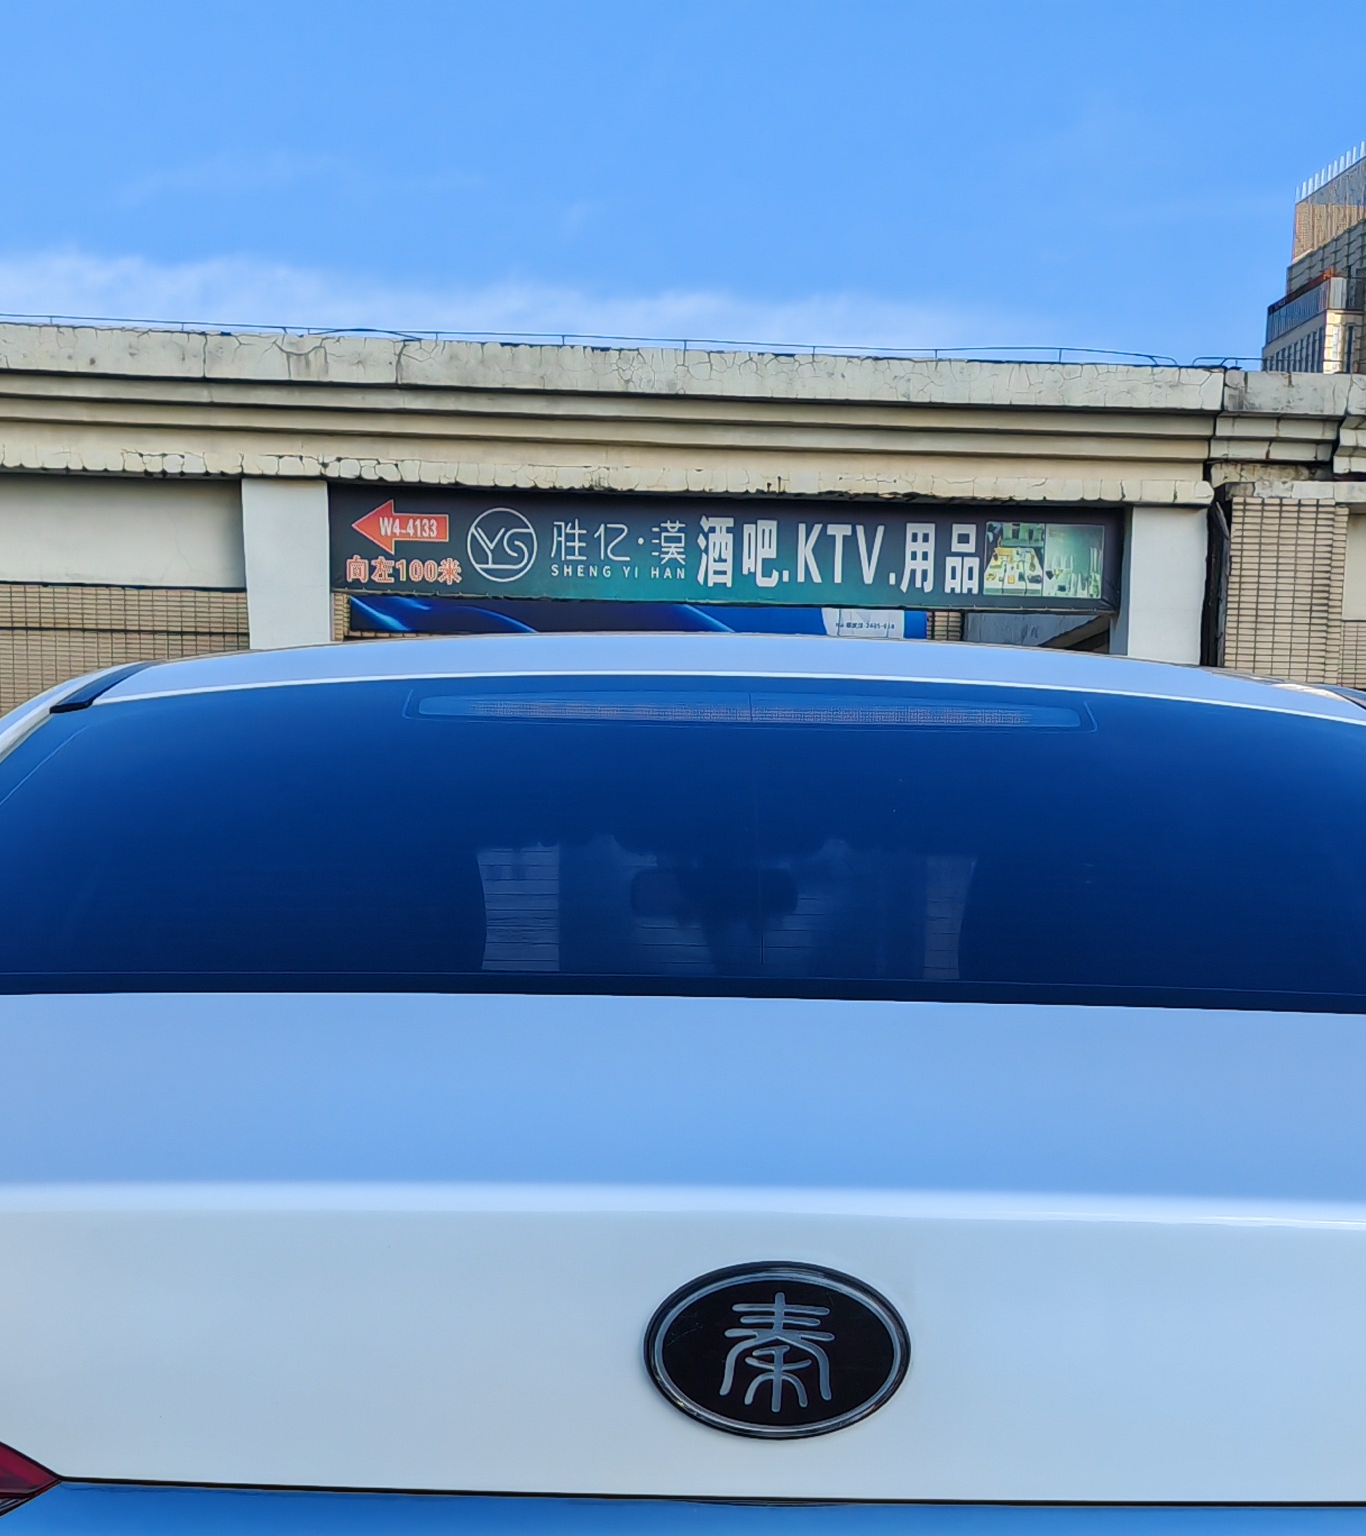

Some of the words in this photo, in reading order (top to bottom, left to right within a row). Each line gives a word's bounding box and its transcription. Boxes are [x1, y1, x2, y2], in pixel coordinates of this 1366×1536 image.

[379, 516, 438, 538] W4-4133
[346, 554, 463, 585] 向左100米
[551, 564, 612, 579] SHENG
[622, 565, 639, 579] YI
[651, 565, 685, 580] HAN
